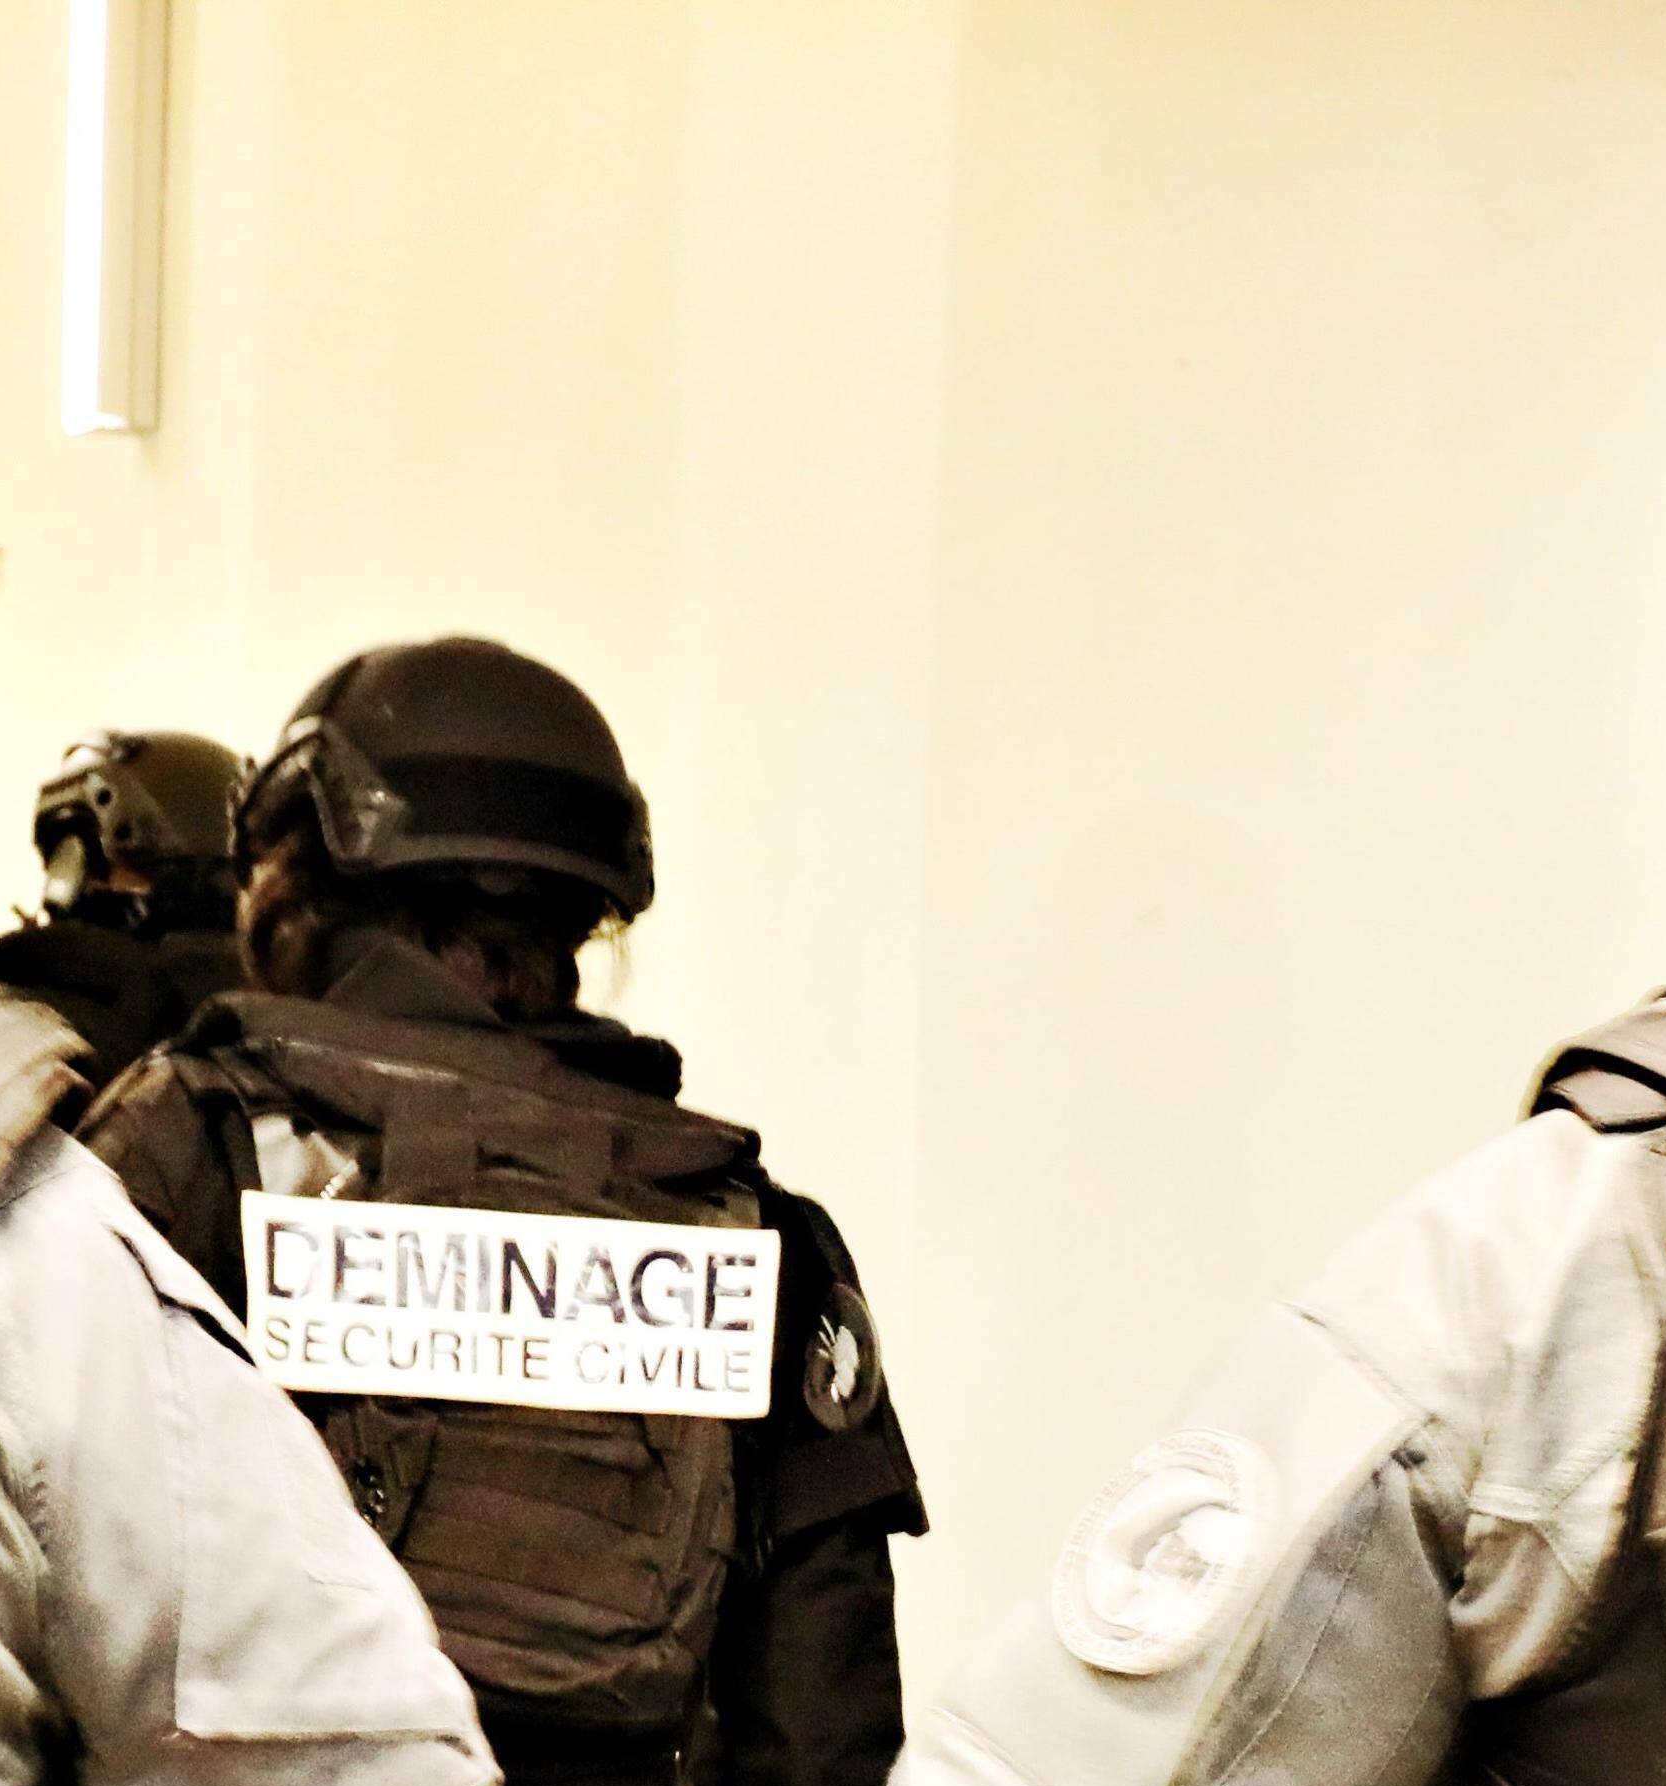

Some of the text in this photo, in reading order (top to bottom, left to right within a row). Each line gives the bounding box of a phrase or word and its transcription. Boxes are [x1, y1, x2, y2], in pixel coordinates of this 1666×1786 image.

[265, 1219, 757, 1332] DEMINAGE
[265, 1316, 752, 1393] SECURITE CIVILE
